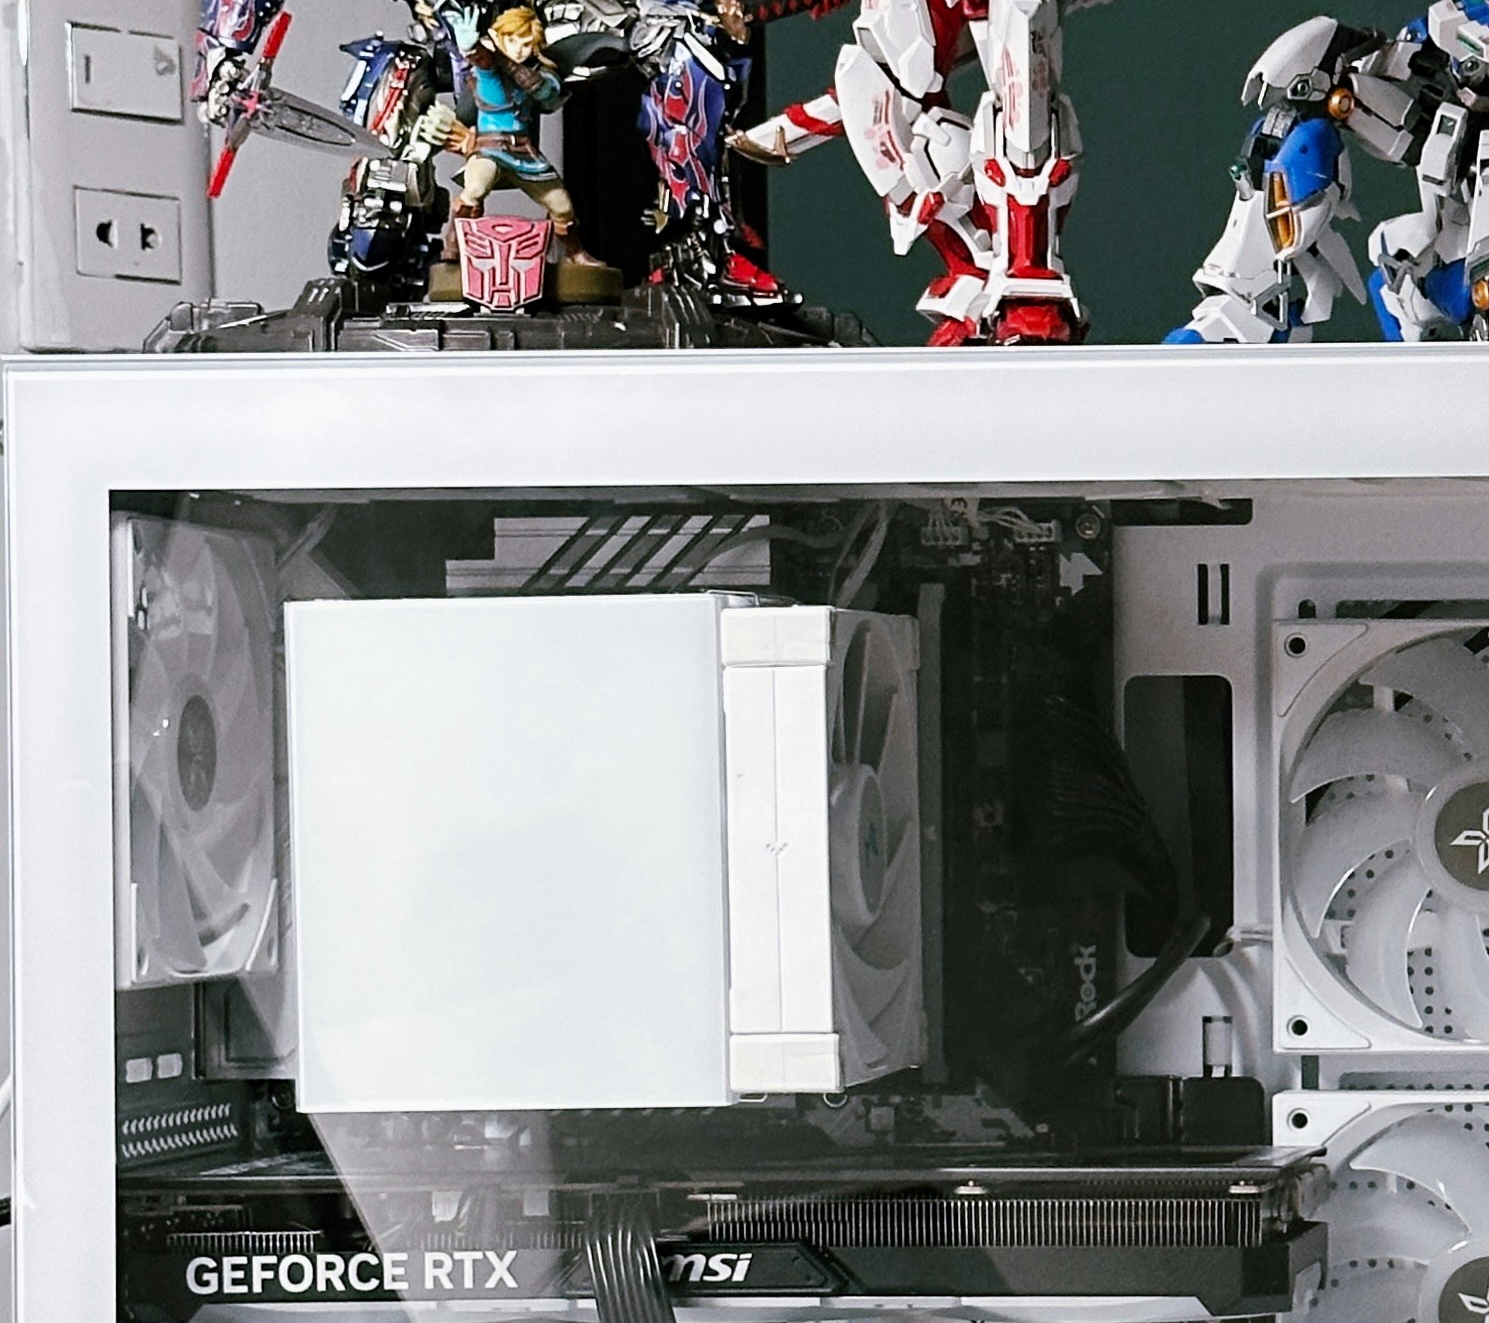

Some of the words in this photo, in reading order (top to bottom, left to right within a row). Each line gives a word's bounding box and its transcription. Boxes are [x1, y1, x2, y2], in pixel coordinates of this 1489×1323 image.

[1074, 944, 1097, 1022] Rock
[185, 1252, 410, 1294] GEFORCE
[424, 1249, 519, 1290] RTX
[664, 1253, 752, 1282] msi
